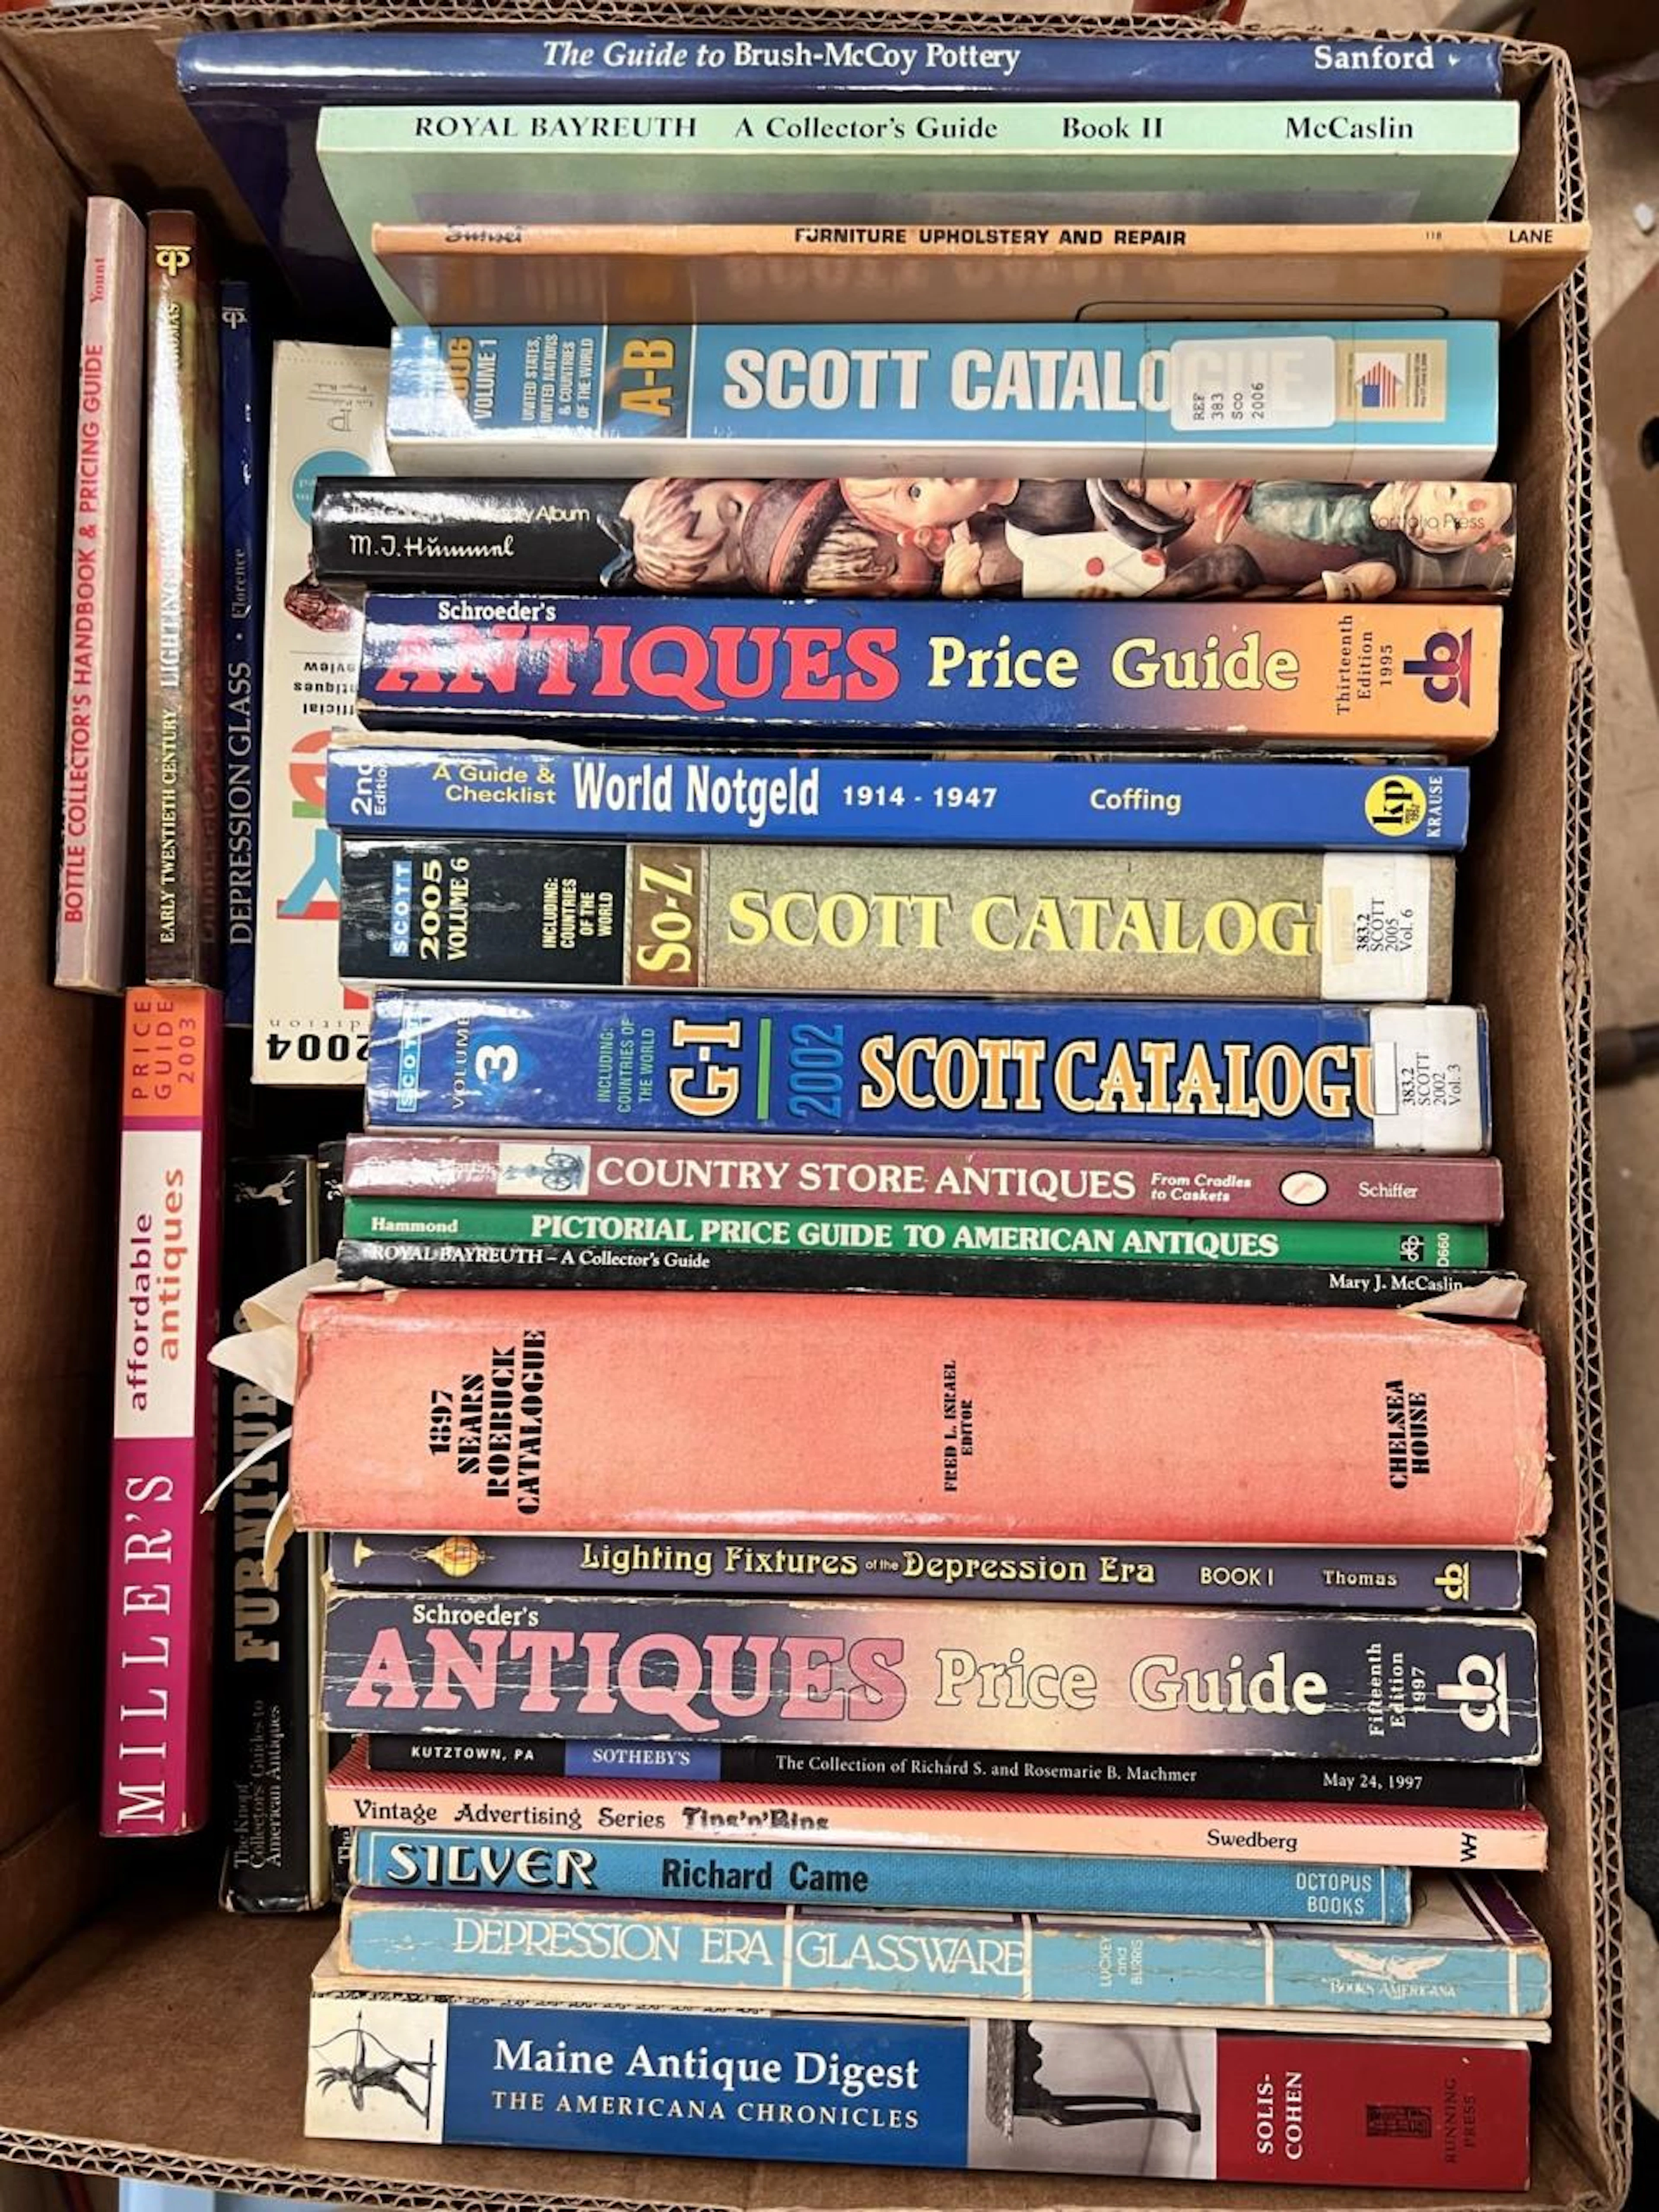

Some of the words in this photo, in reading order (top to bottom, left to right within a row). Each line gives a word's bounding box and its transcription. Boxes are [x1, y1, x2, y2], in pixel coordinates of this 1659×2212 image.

[1314, 45, 1434, 70] Sanford
[415, 117, 518, 137] ROYAL
[531, 117, 696, 138] BAYREUTH
[1062, 117, 1131, 139] Book
[1142, 118, 1163, 139] II
[1285, 117, 1414, 139] McCaslin
[795, 228, 906, 244] FURNITURE
[919, 229, 1049, 245] UPHOLSTERY
[1059, 230, 1103, 245] AND
[1114, 230, 1186, 245] REPAIR
[1509, 229, 1553, 244] LANE
[90, 258, 106, 302] Yount
[480, 338, 498, 347] 1
[543, 334, 559, 381] NATIONS
[578, 338, 594, 378] WORLD
[83, 344, 103, 412] GUIDE
[474, 353, 497, 420] VOLUME
[560, 341, 575, 398] COUNTRIES
[578, 379, 592, 401] THE
[723, 348, 929, 410] SCOTT
[540, 384, 555, 423] UNITED
[576, 403, 590, 419] OF
[1193, 392, 1205, 420] REF
[1211, 392, 1225, 420] 383
[1251, 381, 1265, 420] 2006
[79, 421, 100, 513] PRICING
[79, 523, 97, 539] &
[537, 506, 590, 521] Album
[231, 548, 251, 619] Florence
[72, 549, 95, 684] HANDBOOK
[437, 601, 557, 622] Schroeder's
[375, 624, 901, 713] ANTIQUES
[927, 634, 1080, 688] Price
[1111, 632, 1300, 691] Guide
[1357, 631, 1373, 700] Edition
[1380, 643, 1394, 687] 1995
[229, 661, 252, 756] GLASS
[67, 694, 91, 837] COLLECTOR'S
[432, 765, 451, 781] A
[460, 766, 528, 783] Guide
[539, 767, 556, 784] &
[573, 761, 673, 811] World
[686, 764, 819, 828] Notgeld
[843, 786, 905, 807] 1914
[934, 786, 998, 808] 1947
[1426, 775, 1443, 837] KRAUSE
[230, 763, 253, 946] DEPRESSION
[451, 856, 470, 871] 6
[64, 845, 84, 924] BOTTLE
[392, 864, 410, 954] SCOTT
[446, 877, 470, 961] VOLUME
[542, 877, 559, 949] INCLUDING:
[560, 877, 577, 949] COUNTRIES
[598, 891, 613, 937] WORLD
[636, 863, 695, 973] So-Z
[1371, 897, 1385, 952] SCOTT
[1357, 913, 1370, 952] 383.2
[1385, 918, 1399, 952] 2005
[131, 1002, 151, 1099] PRICE
[155, 1001, 173, 1100] GUIDE
[178, 1018, 196, 1084] 2003
[620, 1017, 632, 1040] OF
[641, 1027, 656, 1068] WORLD
[451, 1016, 470, 1110] VOLUME
[475, 1043, 518, 1084] 3
[617, 1044, 632, 1114] COUNTRIES
[670, 1018, 742, 1119] G-I
[860, 1034, 1046, 1111] SCOTT
[1417, 1052, 1431, 1106] SCOTT
[1449, 1063, 1461, 1072] 3
[639, 1076, 653, 1104] THE
[1401, 1068, 1415, 1105] 383.2
[1448, 1079, 1462, 1106] Vol.
[597, 1158, 790, 1191] COUNTRY
[800, 1162, 927, 1193] STORE
[935, 1167, 1137, 1201] ANTIQUES
[1150, 1189, 1168, 1201] to
[1170, 1188, 1230, 1203] Caskets
[1358, 1181, 1419, 1199] Schiffer
[371, 1217, 458, 1235] Hammond
[531, 1214, 693, 1244] PICTORIAL
[701, 1219, 791, 1245] PRICE
[797, 1222, 893, 1248] GUIDE
[905, 1224, 946, 1249] TO
[953, 1225, 1114, 1253] AMERICAN
[1122, 1229, 1280, 1260] ANTIQUES
[372, 1244, 432, 1262] ROYAL
[439, 1244, 543, 1264] BAYREUTH
[561, 1252, 575, 1265] A
[580, 1250, 660, 1268] Collector's
[664, 1253, 711, 1269] Guide
[1329, 1273, 1369, 1292] Mary
[1373, 1277, 1386, 1291] J.
[1391, 1278, 1464, 1292] McCaslin
[127, 1213, 153, 1412] affordable
[458, 1374, 485, 1474] SEARS
[486, 1346, 515, 1497] ROEBUCK
[518, 1330, 546, 1515] CATALOGUE
[961, 1400, 973, 1455] EDITOR
[1385, 1380, 1407, 1488] CHELSEA
[1408, 1392, 1430, 1474] HOUSE
[1200, 1566, 1262, 1585] BOOK
[1323, 1569, 1398, 1587] Thomas
[117, 1475, 173, 1824] MILLER'S
[345, 1626, 907, 1733] ANTIQUES
[935, 1647, 1099, 1710] Price
[1129, 1651, 1329, 1715] Guide
[1366, 1643, 1386, 1737] Fifteenth
[1389, 1651, 1407, 1729] Edition
[266, 1705, 285, 1782] Antiques
[591, 1747, 690, 1766] SOTHEBY'S
[776, 1755, 804, 1770] The
[808, 1756, 886, 1773] Collection
[890, 1759, 905, 1774] of
[911, 1760, 968, 1776] Richard
[973, 1761, 987, 1776] S.
[991, 1762, 1019, 1777] and
[1024, 1762, 1103, 1779] Rosemarie
[1107, 1765, 1121, 1780] B.
[1127, 1766, 1198, 1782] Machmer
[1322, 1772, 1354, 1790] May
[1360, 1773, 1382, 1790] 24,
[1388, 1775, 1423, 1789] 1997
[266, 1785, 282, 1868] American
[1207, 1829, 1297, 1852] Swedberg
[1296, 1872, 1372, 1892] OCTOPUS
[1307, 1896, 1365, 1916] BOOKS
[454, 1917, 680, 1961] DEPRESSION
[699, 1929, 774, 1965] ERA
[795, 1932, 1025, 1977] GLASSWARE
[1117, 1947, 1127, 1976] and
[493, 2038, 614, 2075] Maine
[625, 2044, 781, 2091] Antique
[795, 2051, 919, 2097] Digest
[491, 2091, 544, 2112] THE
[555, 2094, 725, 2120] AMERICANA
[737, 2102, 919, 2129] CHRONICLES
[1256, 2074, 1274, 2155] SOLIS-
[1285, 2072, 1303, 2160] COHEN
[1443, 2077, 1458, 2164] RUNNING
[1463, 2095, 1477, 2149] PRESS
